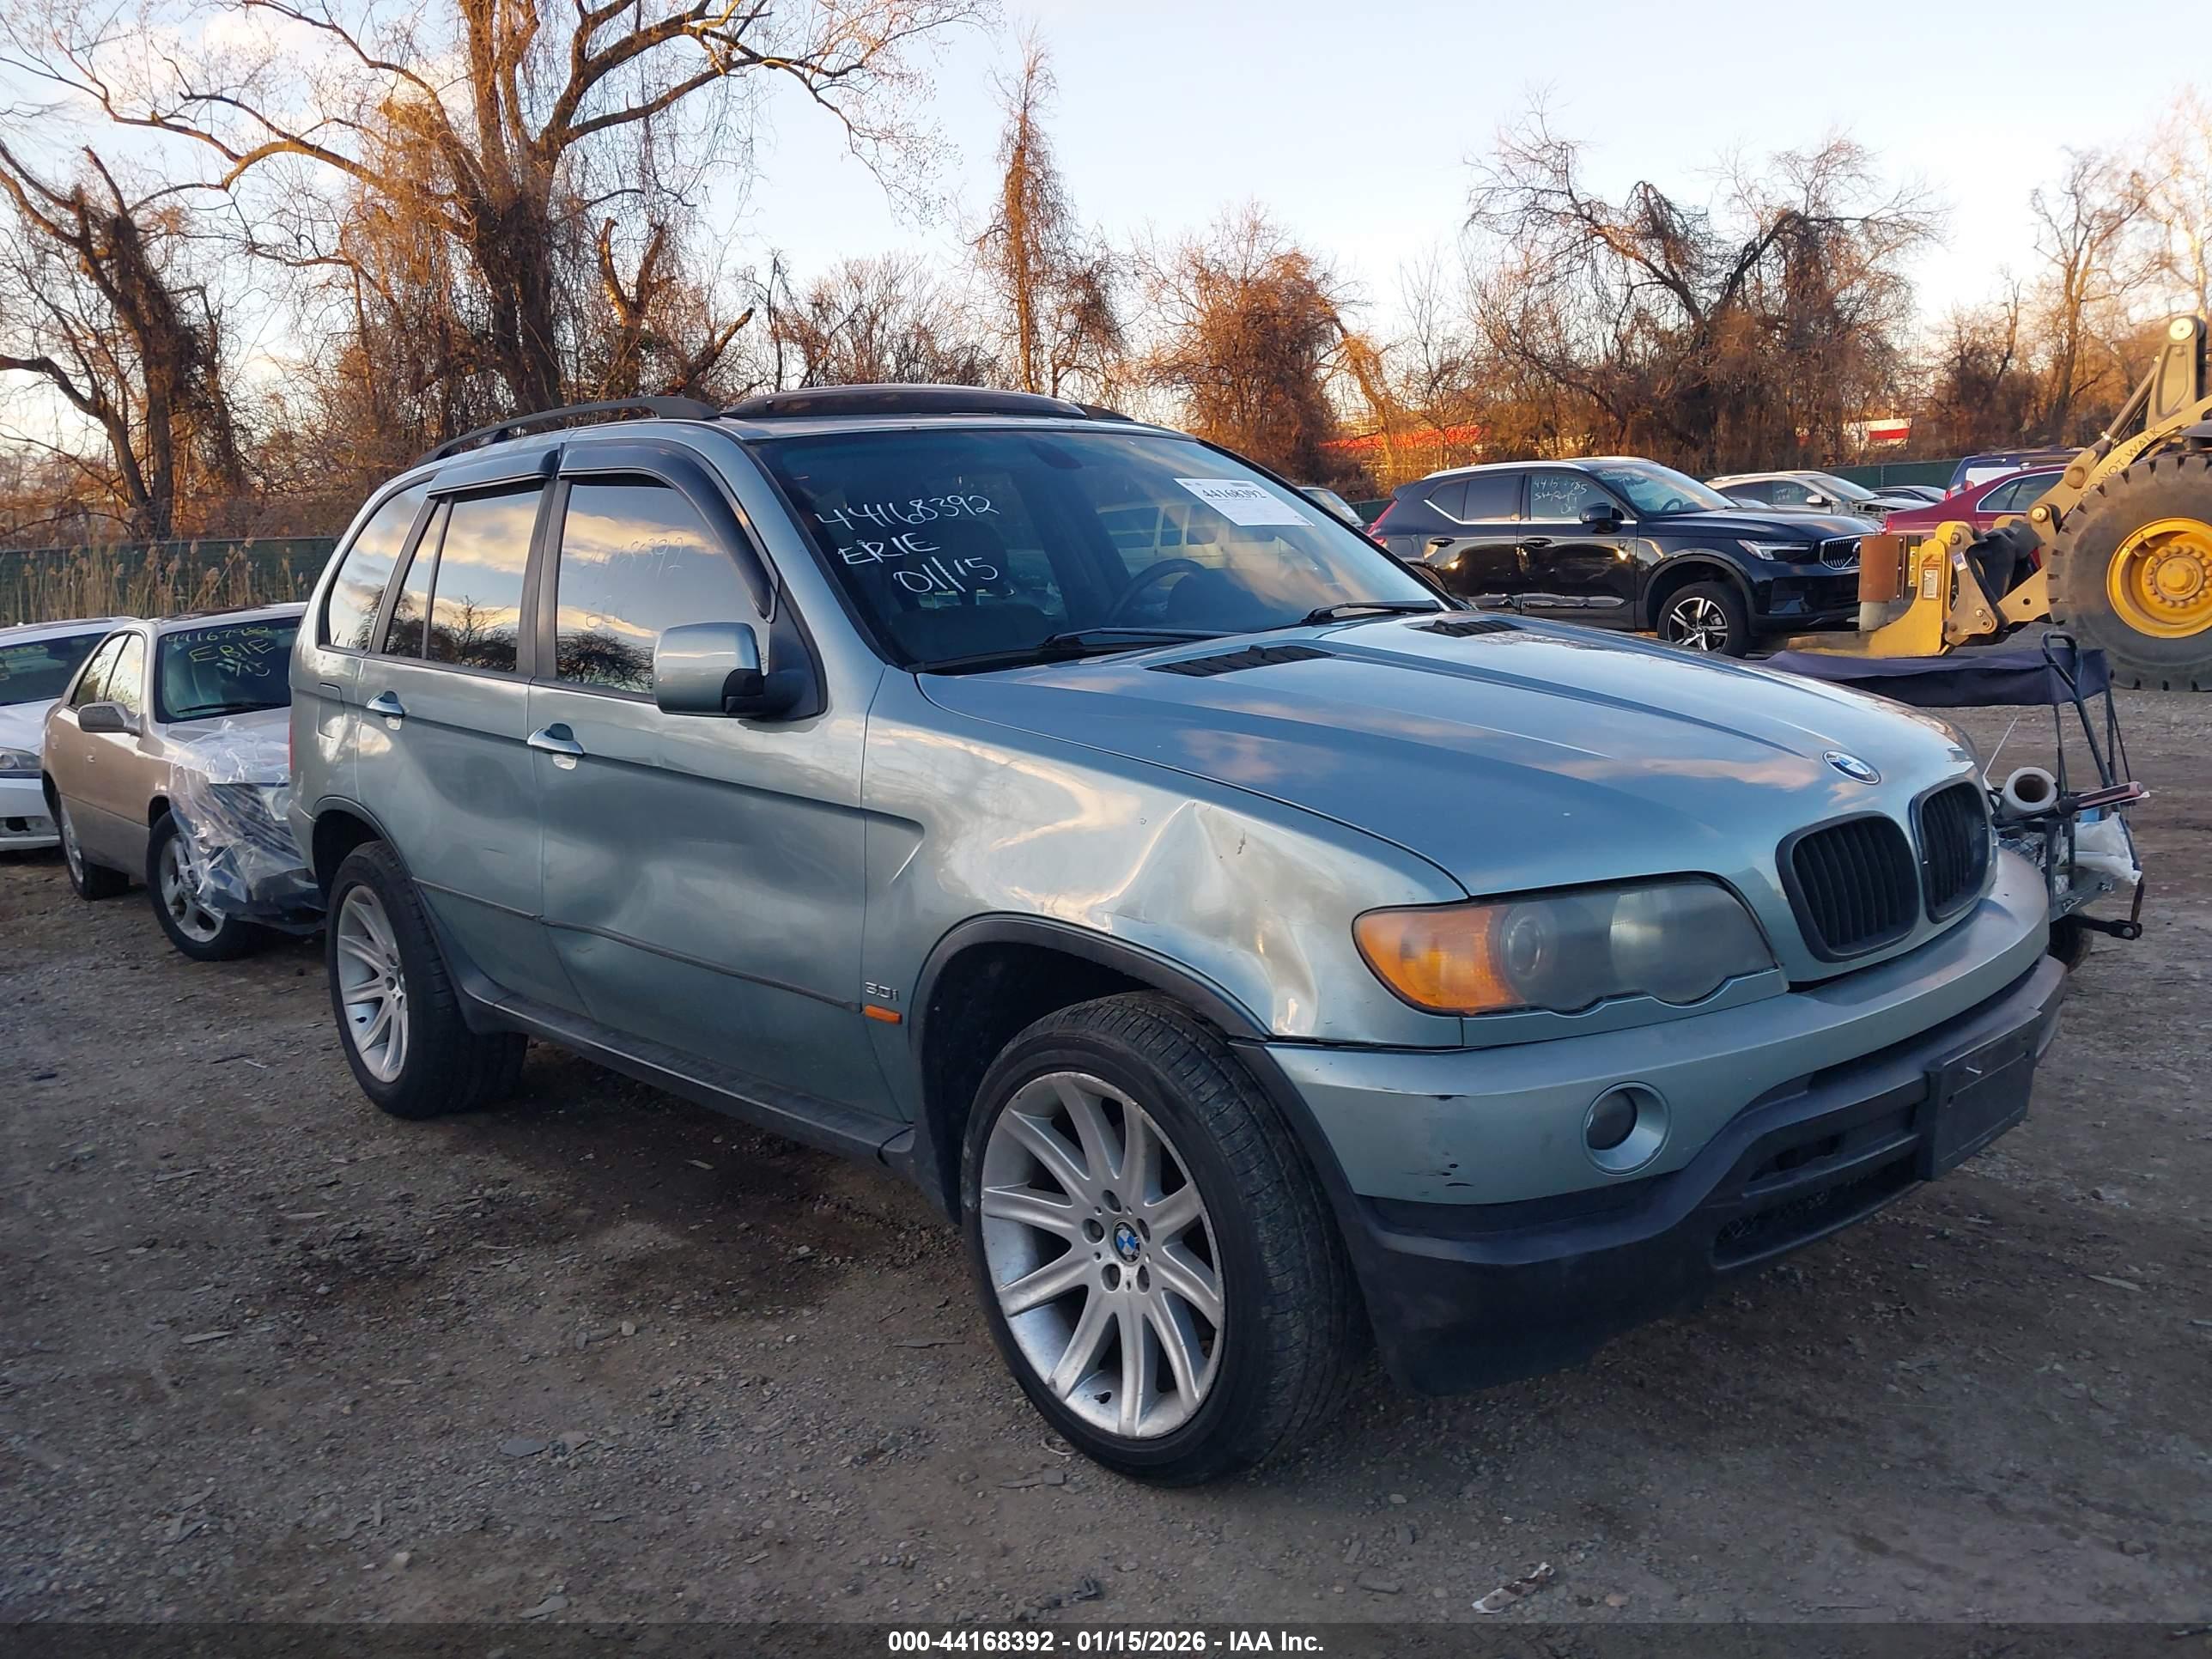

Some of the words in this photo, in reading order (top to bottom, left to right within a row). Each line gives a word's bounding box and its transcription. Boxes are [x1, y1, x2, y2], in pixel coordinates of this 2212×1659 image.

[2125, 426, 2162, 459] WALK
[814, 495, 1000, 531] 44168392
[837, 532, 941, 564] ERIE
[893, 556, 999, 592] 01/15
